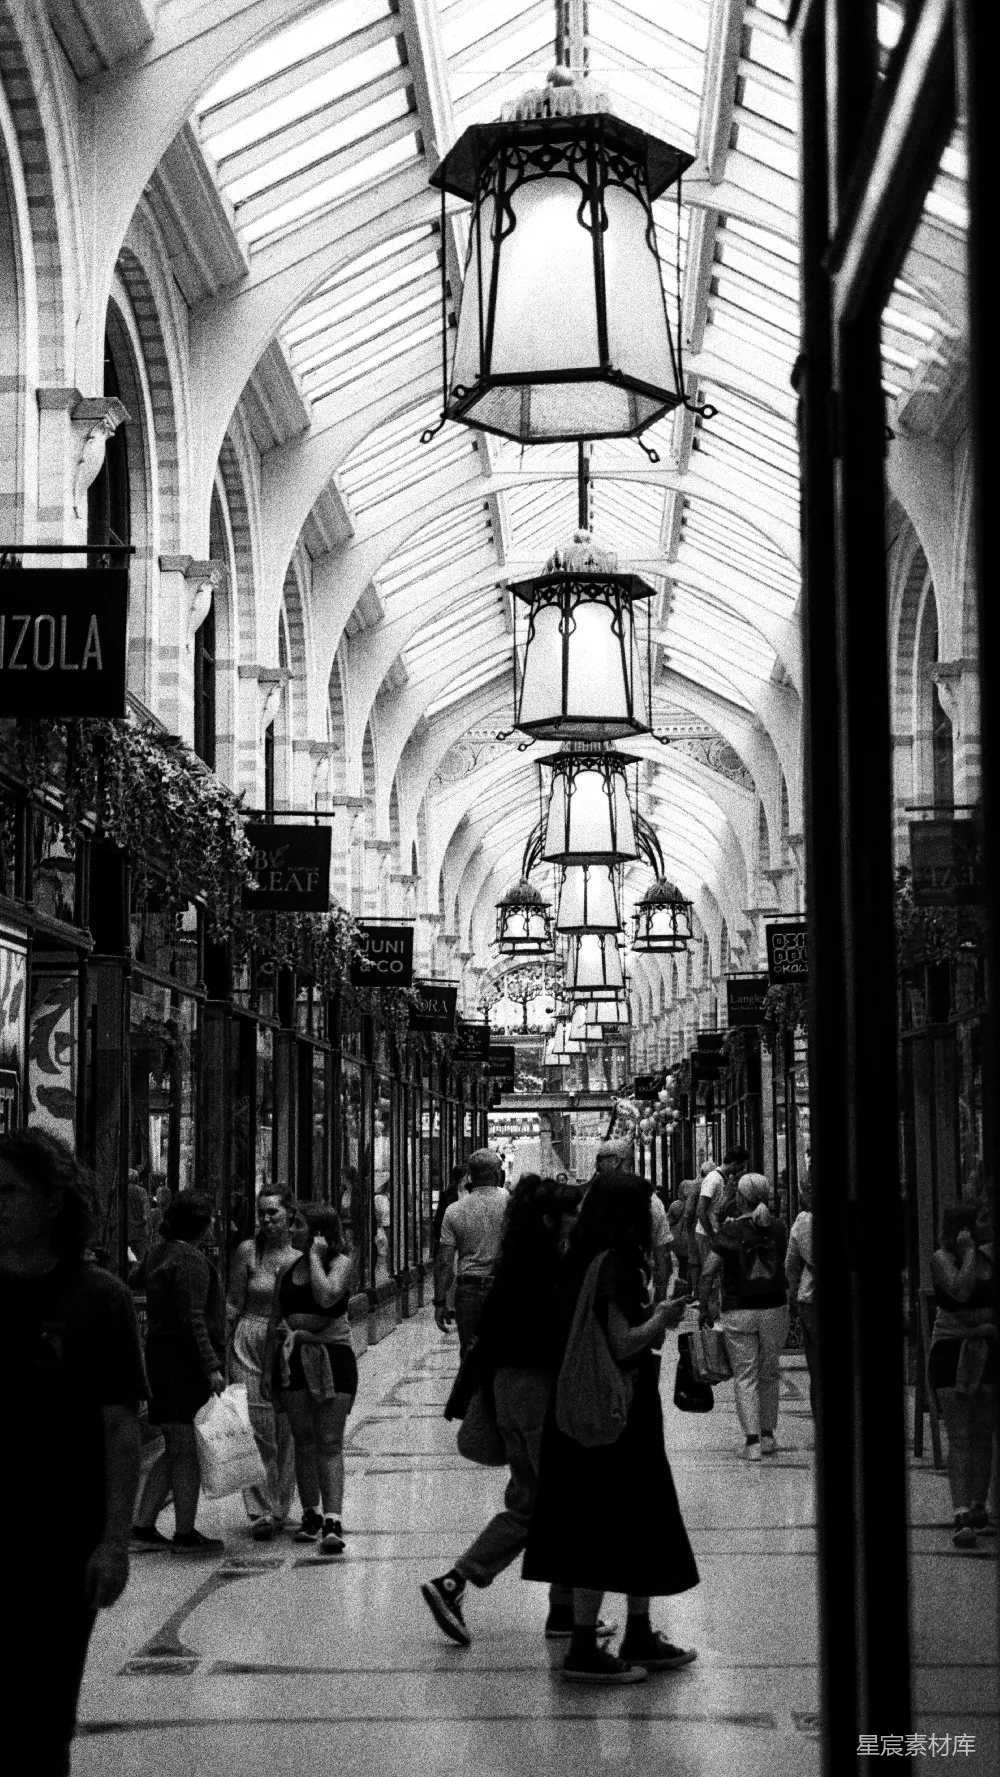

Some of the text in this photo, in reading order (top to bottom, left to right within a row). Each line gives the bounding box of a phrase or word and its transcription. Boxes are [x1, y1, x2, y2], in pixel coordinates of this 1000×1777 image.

[252, 871, 320, 893] LEAF
[358, 940, 404, 954] JUNI
[376, 960, 403, 974] CO
